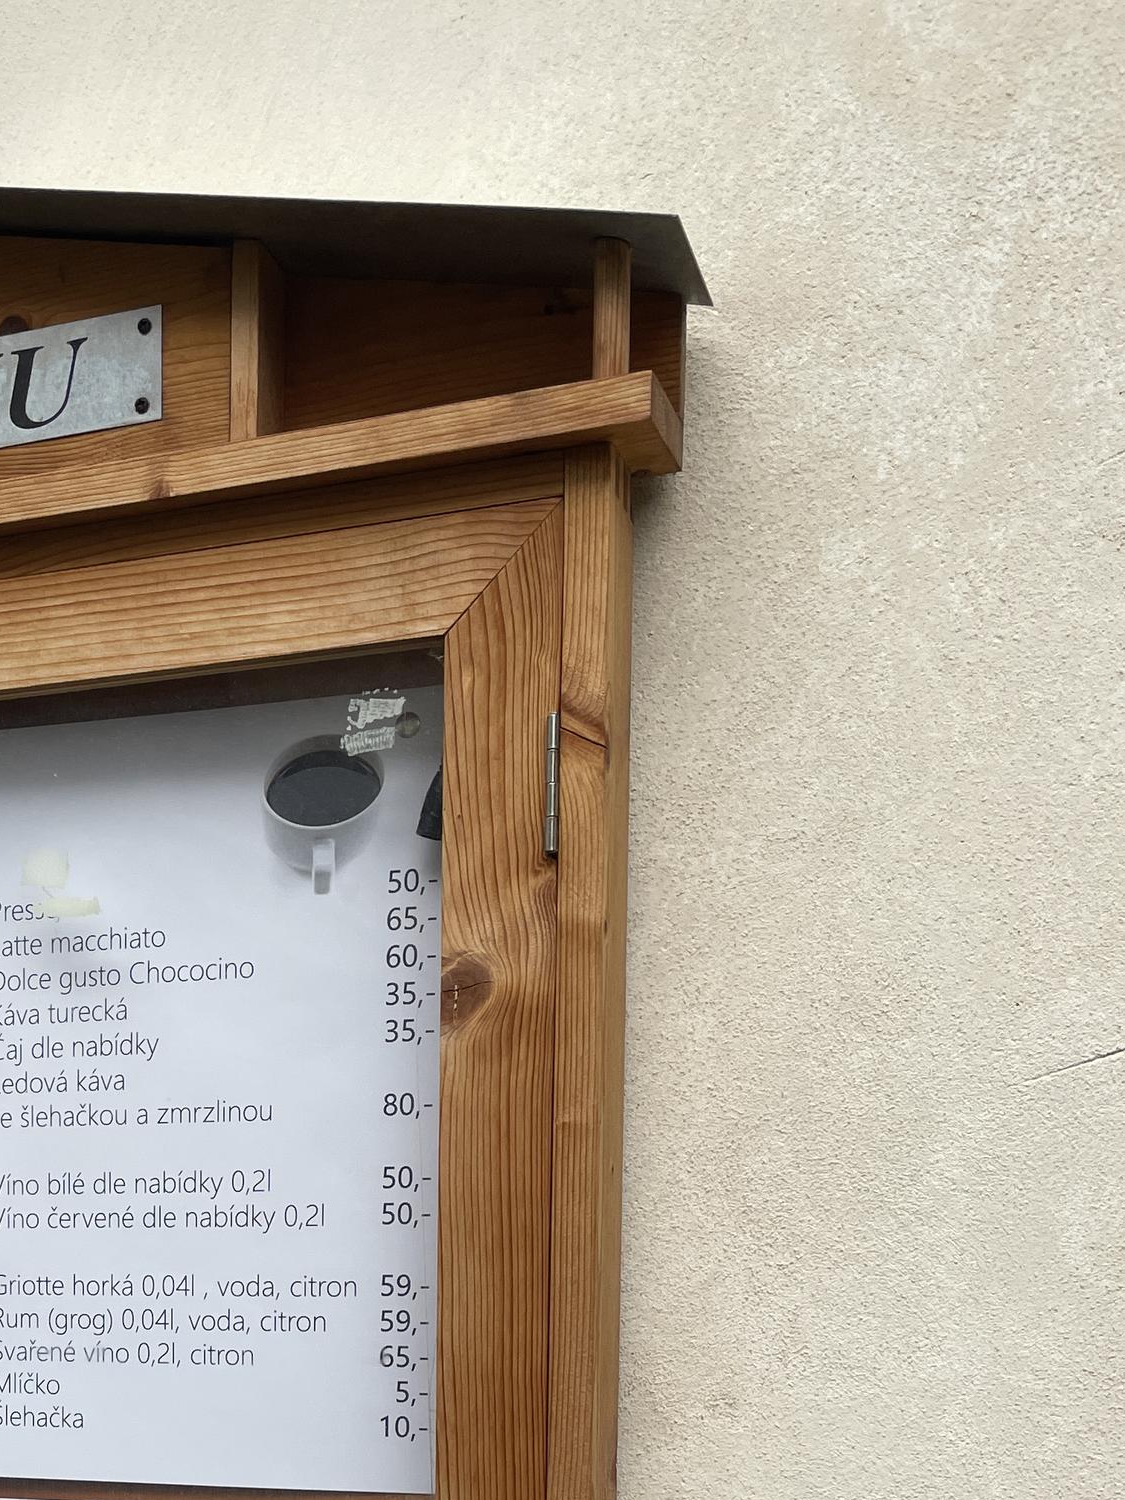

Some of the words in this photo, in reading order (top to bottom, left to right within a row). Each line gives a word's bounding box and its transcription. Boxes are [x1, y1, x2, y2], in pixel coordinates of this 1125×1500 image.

[387, 868, 438, 895] 50,-
[50, 927, 166, 954] macchiato
[386, 907, 437, 933] 65,-
[59, 964, 122, 995] gusto
[129, 958, 255, 985] Chococino
[385, 944, 437, 971] 60,-
[48, 998, 128, 1023] turecká
[385, 981, 436, 1009] 35,-
[31, 1035, 64, 1059] dle
[72, 1033, 159, 1061] nabídky
[384, 1020, 435, 1046] 35,-
[76, 1071, 125, 1092] káva
[20, 1103, 127, 1128] šlehačkou
[156, 1100, 273, 1124] zmrzlinou
[383, 1094, 433, 1119] 80,-
[48, 1172, 85, 1194] bílé
[381, 1166, 431, 1193] 50,-
[47, 1206, 134, 1229] červené
[381, 1202, 431, 1229] 50,-
[72, 1274, 134, 1297] horká
[289, 1275, 358, 1298] citron
[380, 1275, 430, 1301] 59,-
[48, 1308, 113, 1336] (grog)
[260, 1311, 327, 1333] citron
[379, 1311, 429, 1337] 59,-
[83, 1342, 129, 1363] víno
[190, 1344, 254, 1367] citron
[379, 1347, 429, 1372] 65,-
[395, 1381, 429, 1406] 5,-
[380, 1416, 428, 1442] 10,-
